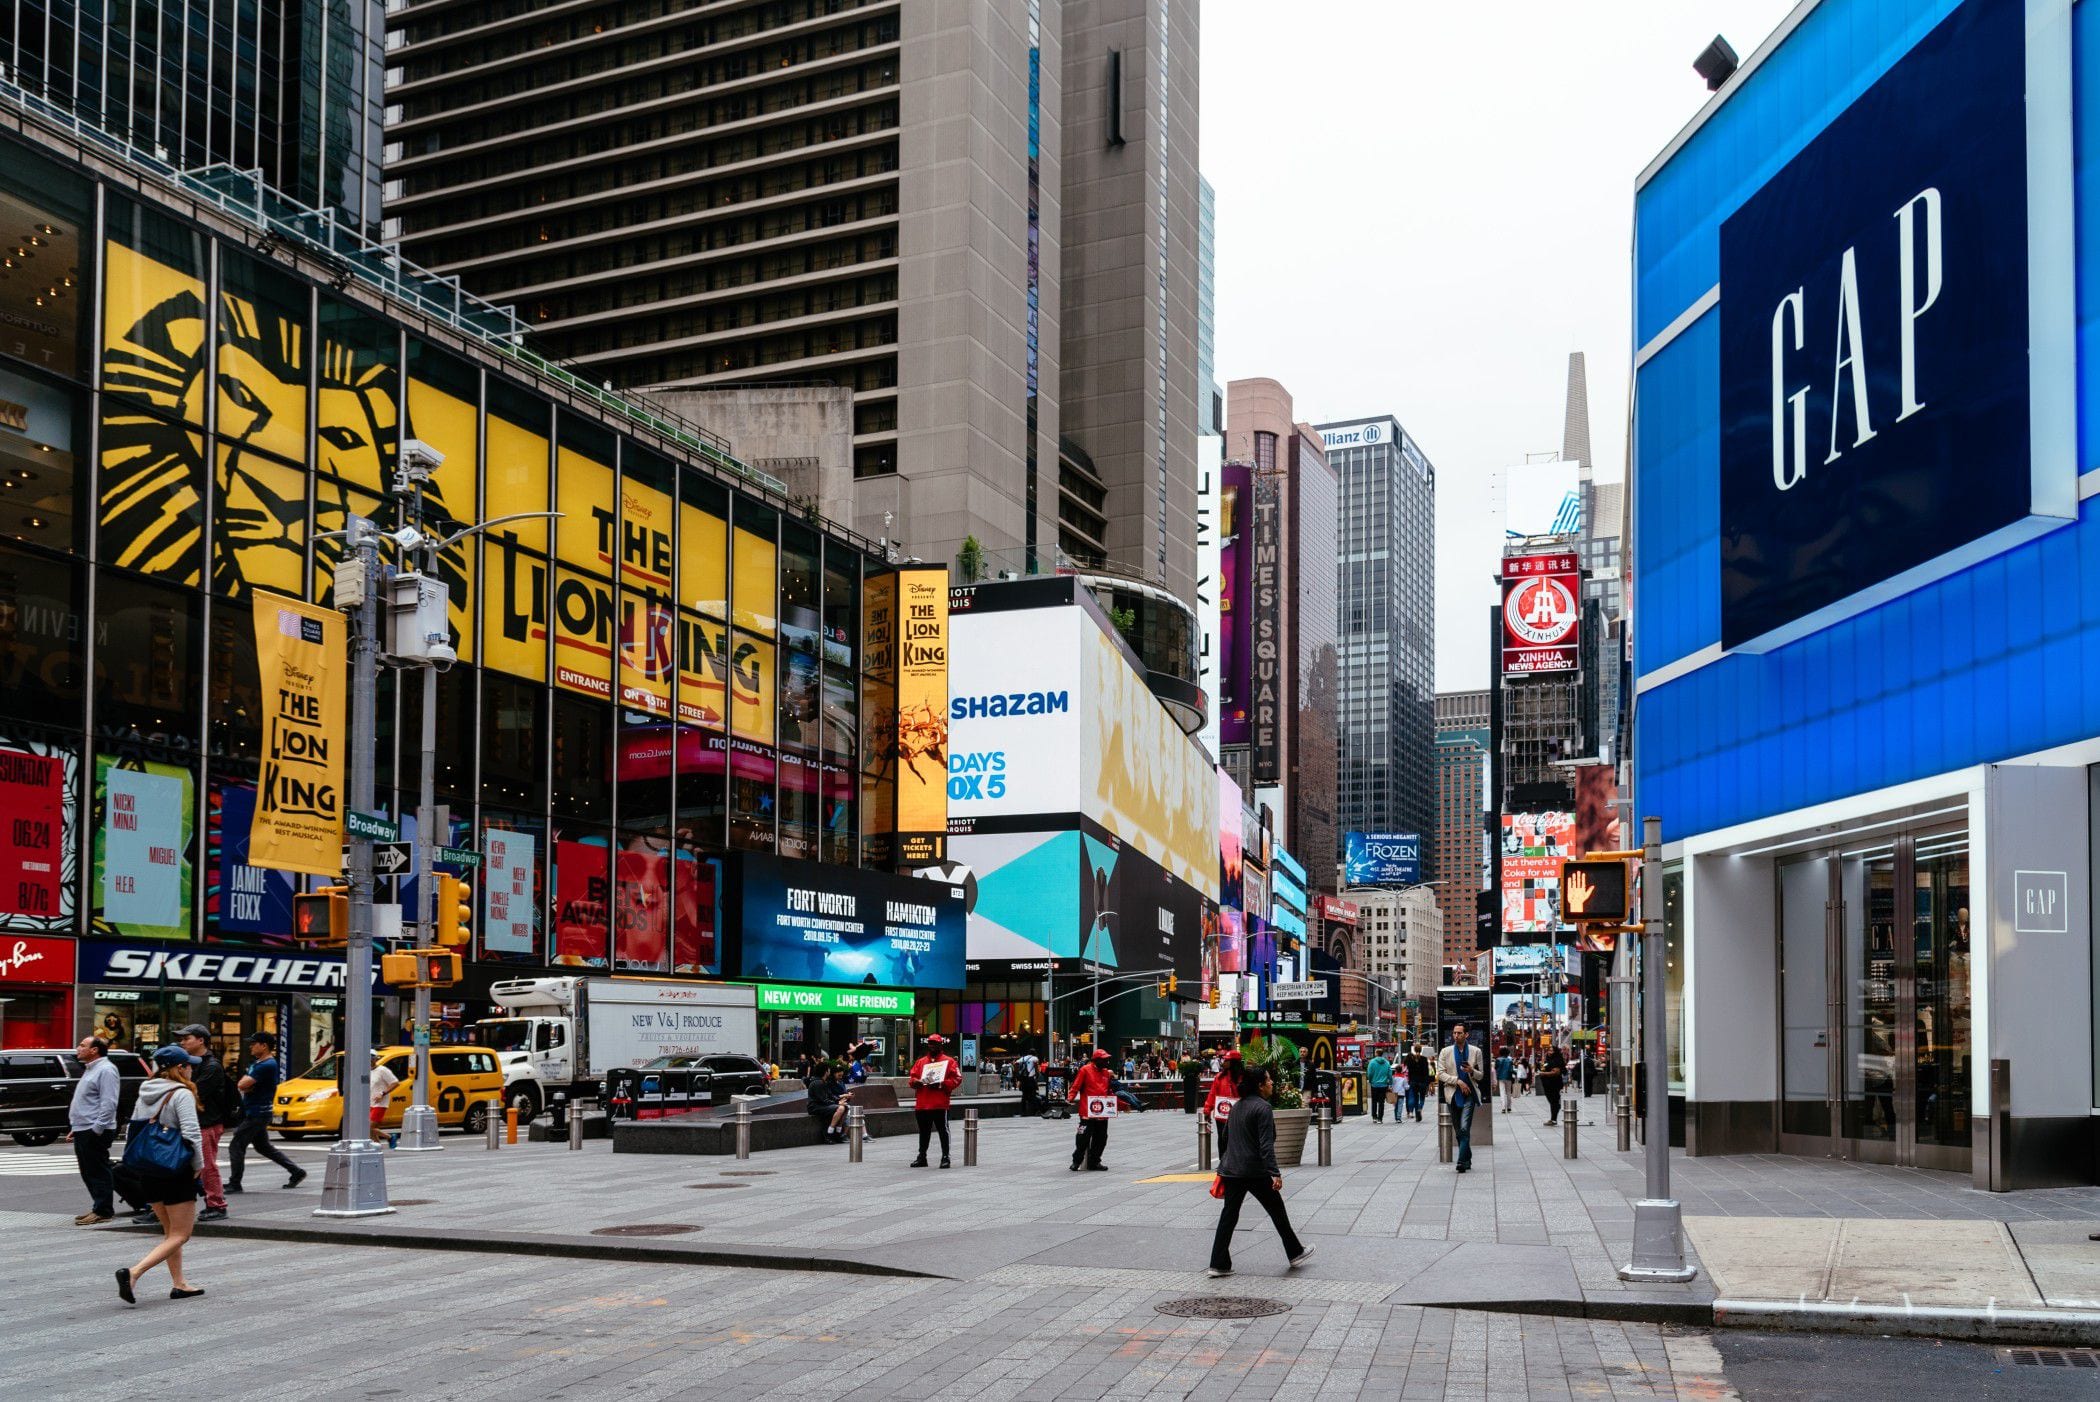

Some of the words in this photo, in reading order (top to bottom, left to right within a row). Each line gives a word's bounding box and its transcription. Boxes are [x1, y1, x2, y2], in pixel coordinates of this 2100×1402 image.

[1772, 187, 1943, 491] GAP
[1323, 431, 1359, 446] llianz
[592, 506, 671, 577] THE
[1256, 503, 1277, 607] TIMES
[503, 530, 635, 653] LION
[908, 583, 936, 595] Disney
[950, 587, 977, 597] IOTT
[910, 605, 935, 617] THE
[645, 586, 760, 693] KING
[906, 620, 940, 640] LION
[1523, 626, 1566, 641] XINHUA
[903, 642, 945, 666] KING
[1519, 651, 1562, 662] XINHUA
[283, 661, 315, 685] Disney
[1508, 661, 1534, 672] NEWS
[1536, 660, 1573, 670] AGENCY
[1256, 618, 1277, 747] SQUARE
[279, 689, 319, 720] THE
[560, 671, 610, 693] ENTRANCE
[624, 688, 639, 701] ON
[645, 693, 667, 709] 45TH
[679, 704, 706, 720] STREET
[271, 717, 328, 761] LION
[0, 753, 54, 788] SUNDAY
[950, 751, 1006, 774] DAYS
[262, 762, 336, 813] KING
[947, 775, 983, 800] OX
[987, 774, 1006, 799] 5
[113, 792, 136, 812] NICKI
[113, 812, 138, 831] MINAJ
[259, 817, 271, 826] THE
[274, 820, 337, 836] AWARD-WINNING
[349, 815, 397, 841] Broadway
[13, 818, 50, 850] 06.24
[275, 828, 290, 837] BEST
[291, 832, 324, 842] MUSICAL
[149, 846, 177, 866] MIGUEL
[377, 852, 400, 866] WAY
[443, 850, 481, 866] Broadway
[1365, 842, 1417, 860] FROZEN
[1503, 859, 1518, 867] but
[1520, 858, 1550, 867] there's
[231, 865, 267, 894] JAMIE
[1503, 869, 1526, 877] Coke
[1528, 869, 1541, 877] for
[230, 892, 261, 921] FOXX
[787, 888, 816, 912] FORT
[818, 892, 856, 917] WORTH
[2026, 888, 2056, 915] GAP
[777, 915, 791, 926] FORT
[791, 916, 811, 928] WORTH
[812, 918, 845, 932] CONVENTION
[845, 921, 864, 933] CENTER
[0, 941, 44, 976] y-Ban
[764, 990, 792, 1005] NEW
[793, 992, 822, 1006] YORK
[837, 994, 859, 1008] LINE
[860, 996, 898, 1009] FRIENDS
[632, 1014, 653, 1027] NEW
[657, 1012, 679, 1030] V&J
[683, 1015, 722, 1028] PRODUCE
